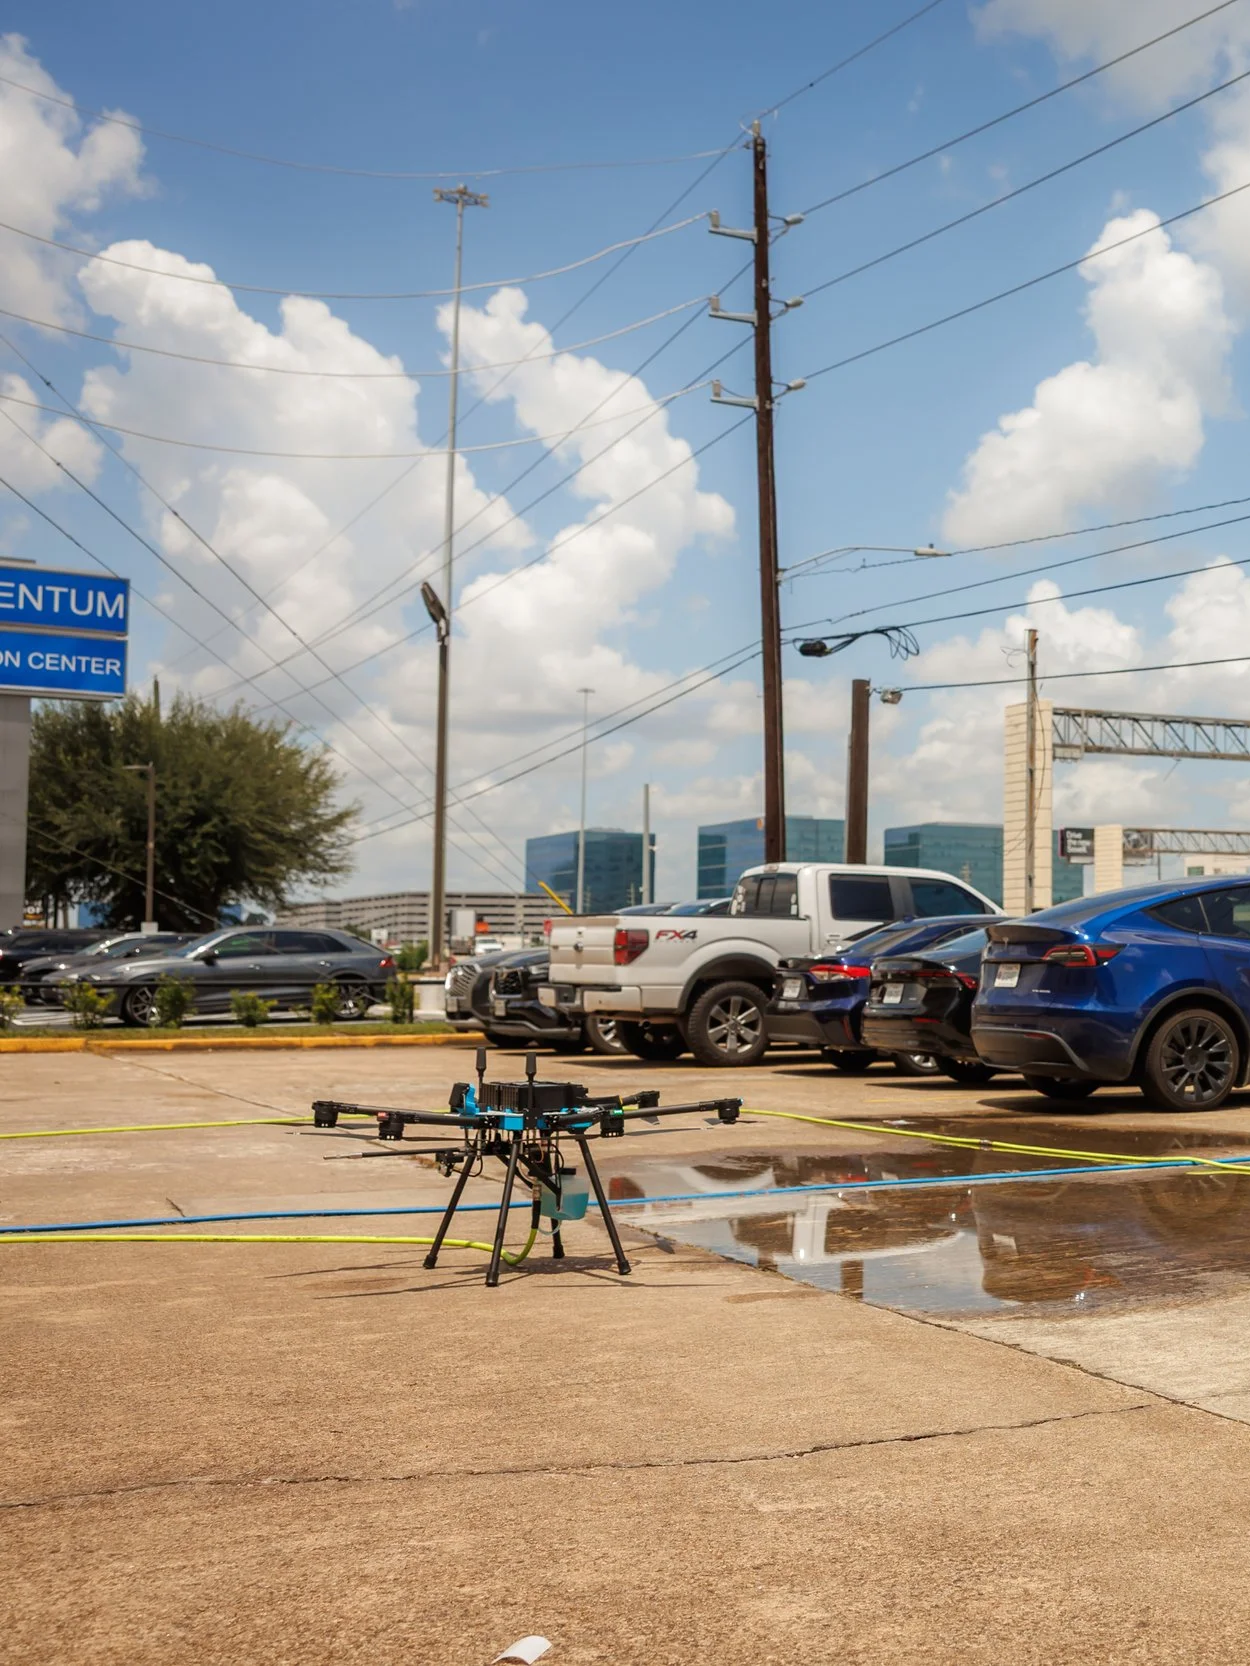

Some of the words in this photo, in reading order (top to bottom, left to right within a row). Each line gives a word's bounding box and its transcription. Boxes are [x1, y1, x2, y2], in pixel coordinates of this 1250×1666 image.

[0, 581, 124, 619] ENTUM
[0, 650, 21, 668] N
[27, 652, 122, 677] CENTER
[654, 929, 698, 941] FX4
